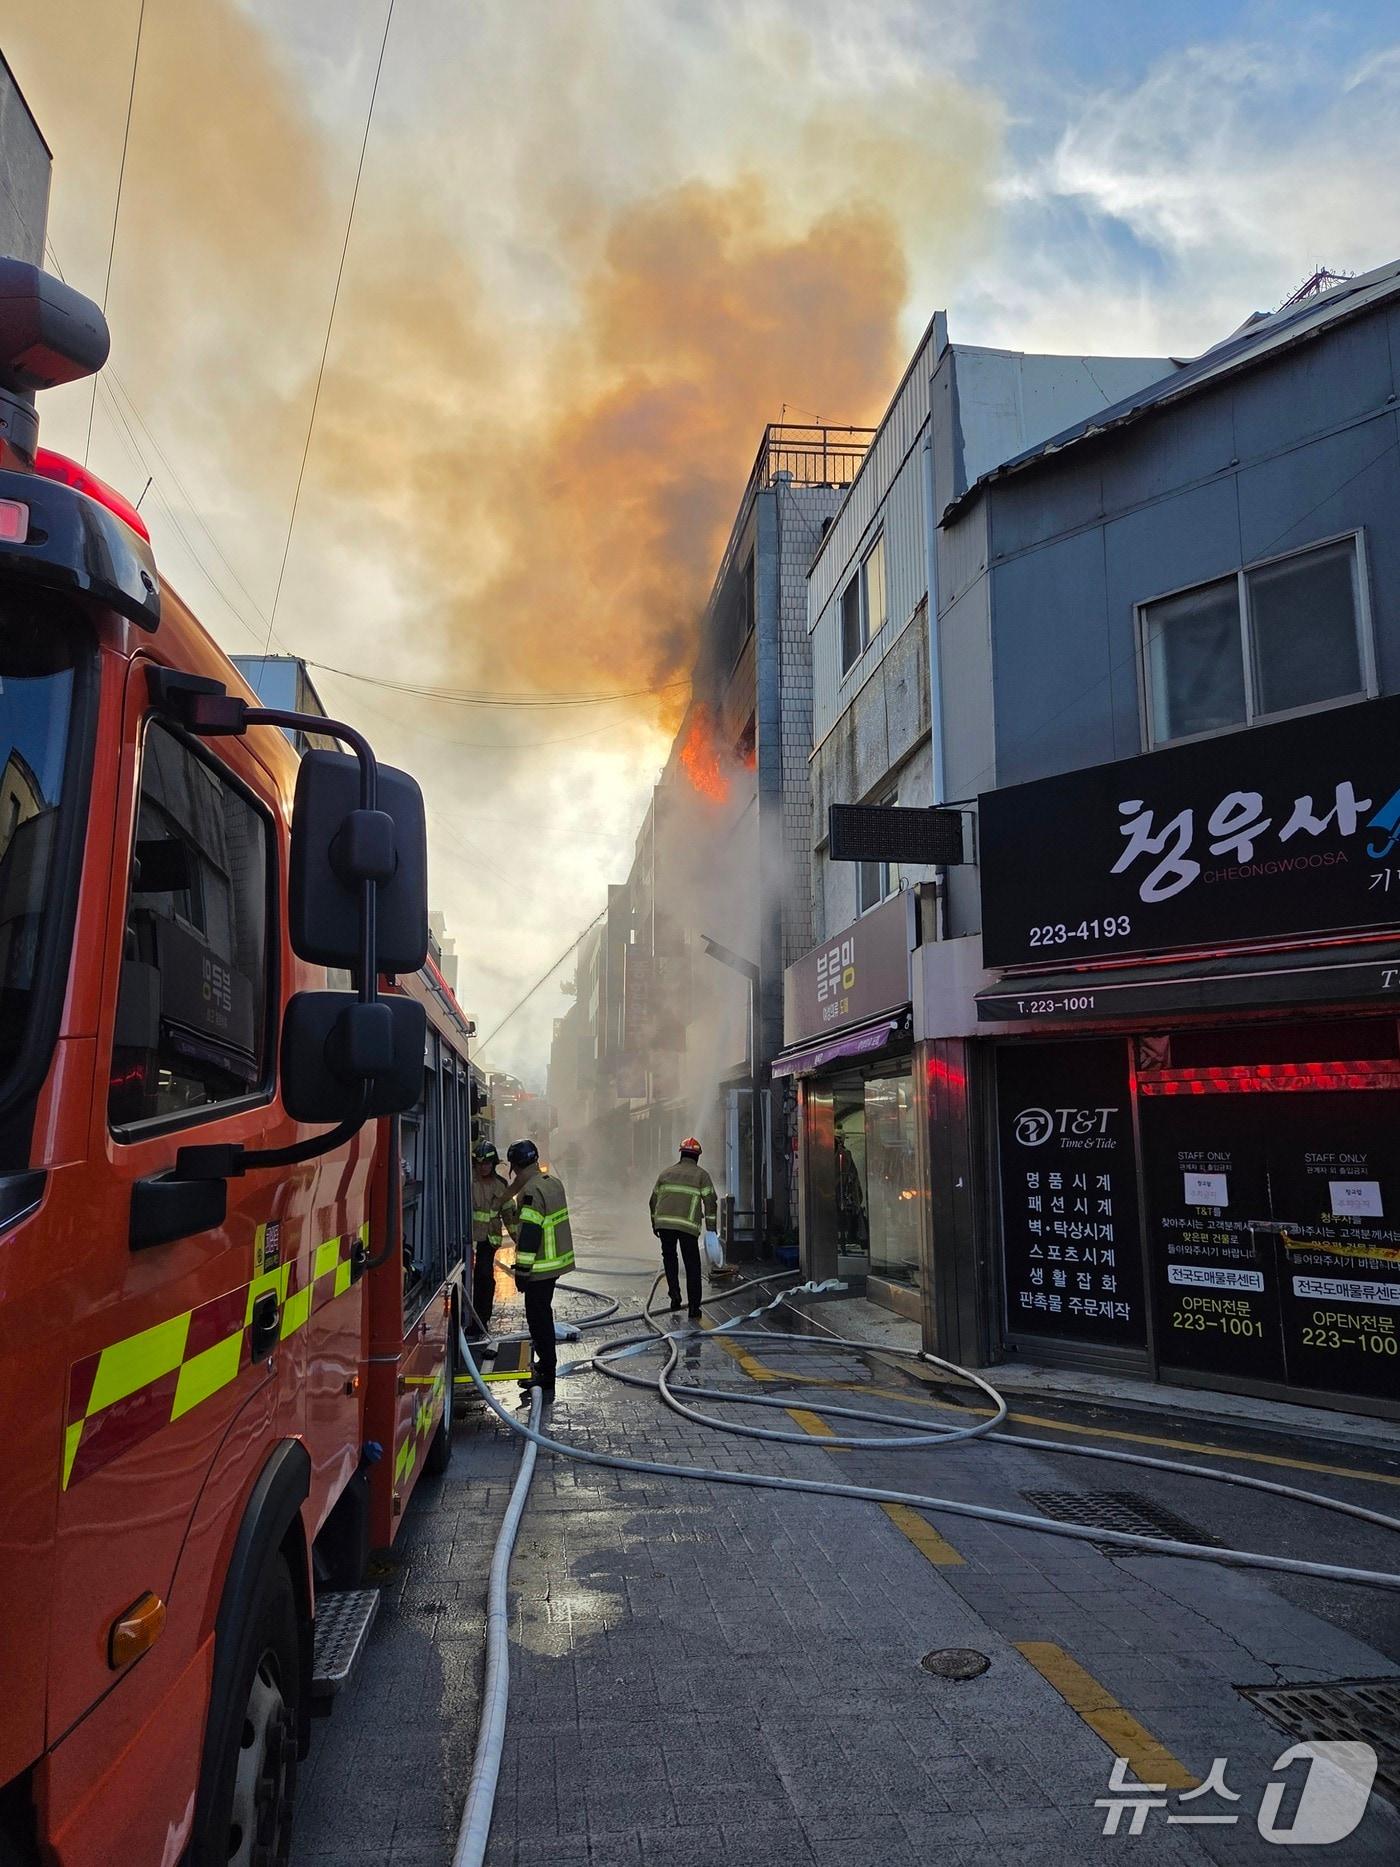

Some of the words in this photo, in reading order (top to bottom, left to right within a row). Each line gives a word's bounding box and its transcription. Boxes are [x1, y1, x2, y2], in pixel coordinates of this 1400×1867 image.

[1110, 781, 1372, 903] 청우사
[1203, 850, 1349, 884] CHEONGWOOSA
[1368, 865, 1400, 893] 기
[1029, 915, 1131, 947] 223-4193
[1381, 969, 1400, 989] T
[1017, 996, 1095, 1014] T.223-1001
[1055, 1107, 1119, 1134] T&T
[1060, 1137, 1083, 1148] Time
[1084, 1138, 1094, 1148] &
[1095, 1138, 1117, 1149] Tide
[1177, 1151, 1204, 1160] STAFF
[1207, 1151, 1232, 1161] ONLY
[1304, 1153, 1335, 1163] STAFF
[1339, 1153, 1368, 1163] ONLY
[1171, 1267, 1260, 1289] 전국도매물류센터
[1020, 1291, 1062, 1312] 판촉물
[1068, 1296, 1130, 1321] 주문제작
[1182, 1297, 1252, 1317] OPEN전문
[1172, 1312, 1264, 1338] 223-1001
[1312, 1311, 1395, 1335] OPEN전문
[1302, 1327, 1400, 1356] 223-100
